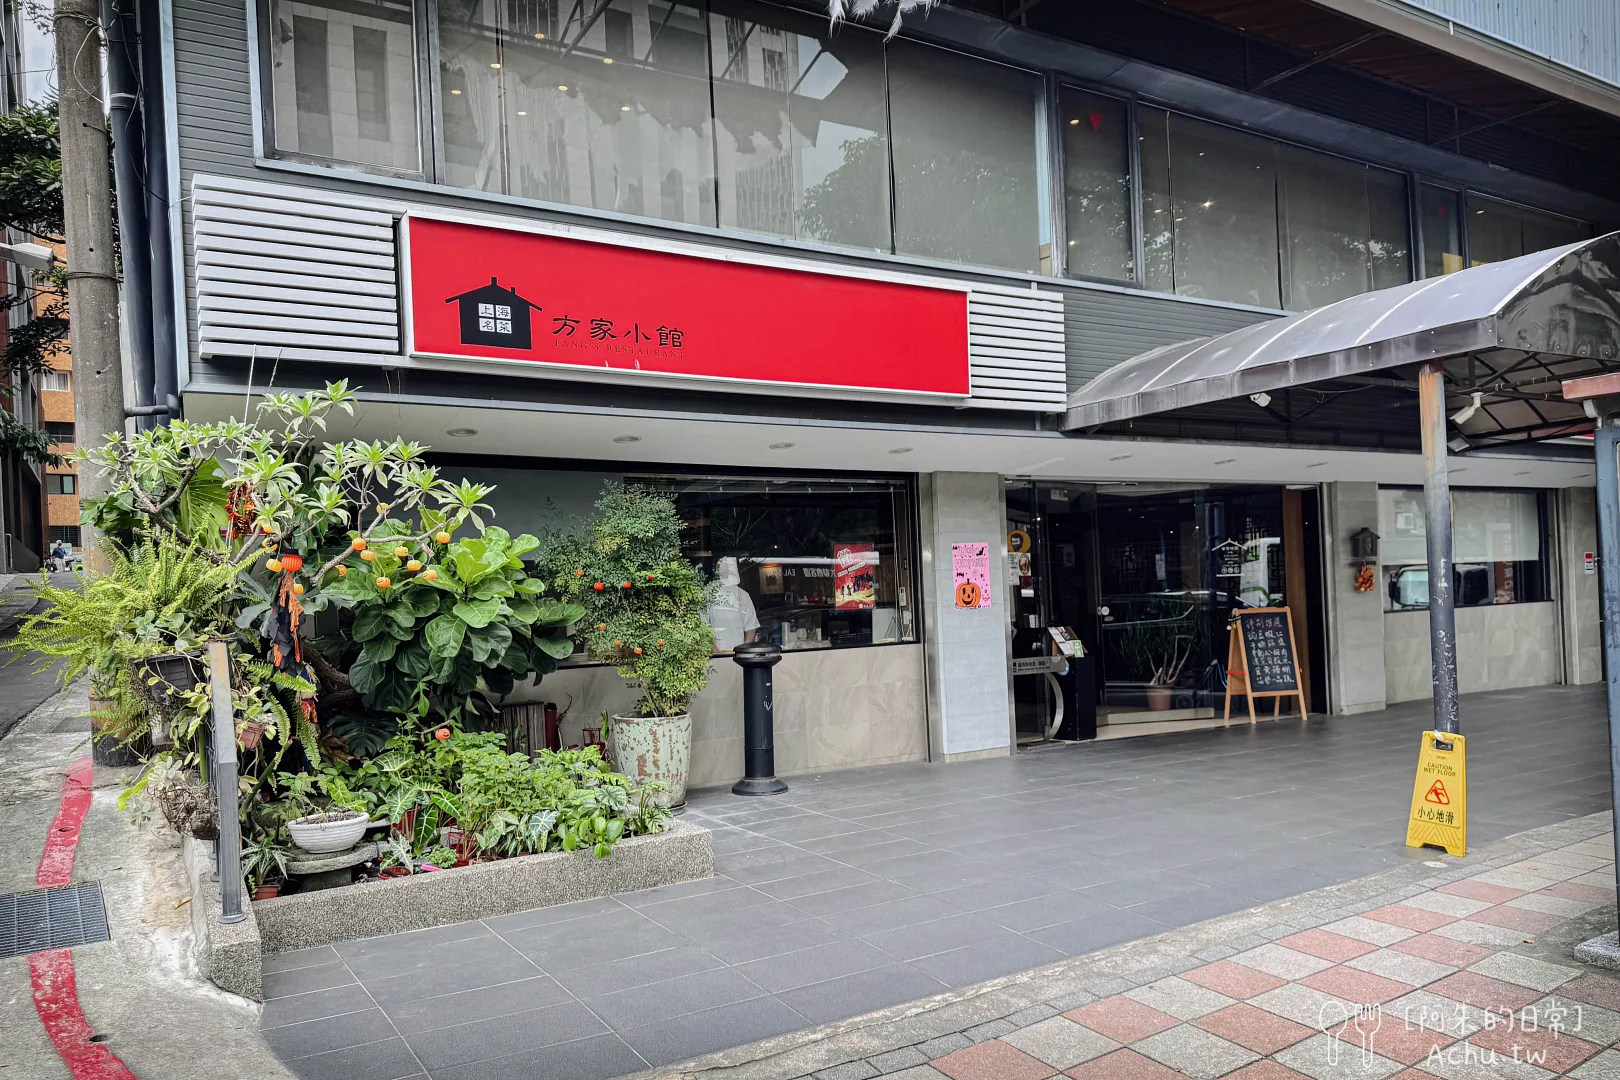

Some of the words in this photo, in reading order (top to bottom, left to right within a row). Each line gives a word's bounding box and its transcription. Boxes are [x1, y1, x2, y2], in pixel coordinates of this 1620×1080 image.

[481, 305, 510, 318] 上海
[481, 319, 511, 333] 名菜
[552, 314, 685, 348] 方家小館
[555, 339, 600, 351] FANG'S
[606, 345, 685, 359] RESTAURANT
[1427, 762, 1453, 771] CAUTION
[1437, 769, 1456, 777] FLOOR
[1417, 805, 1455, 824] 小心地滑
